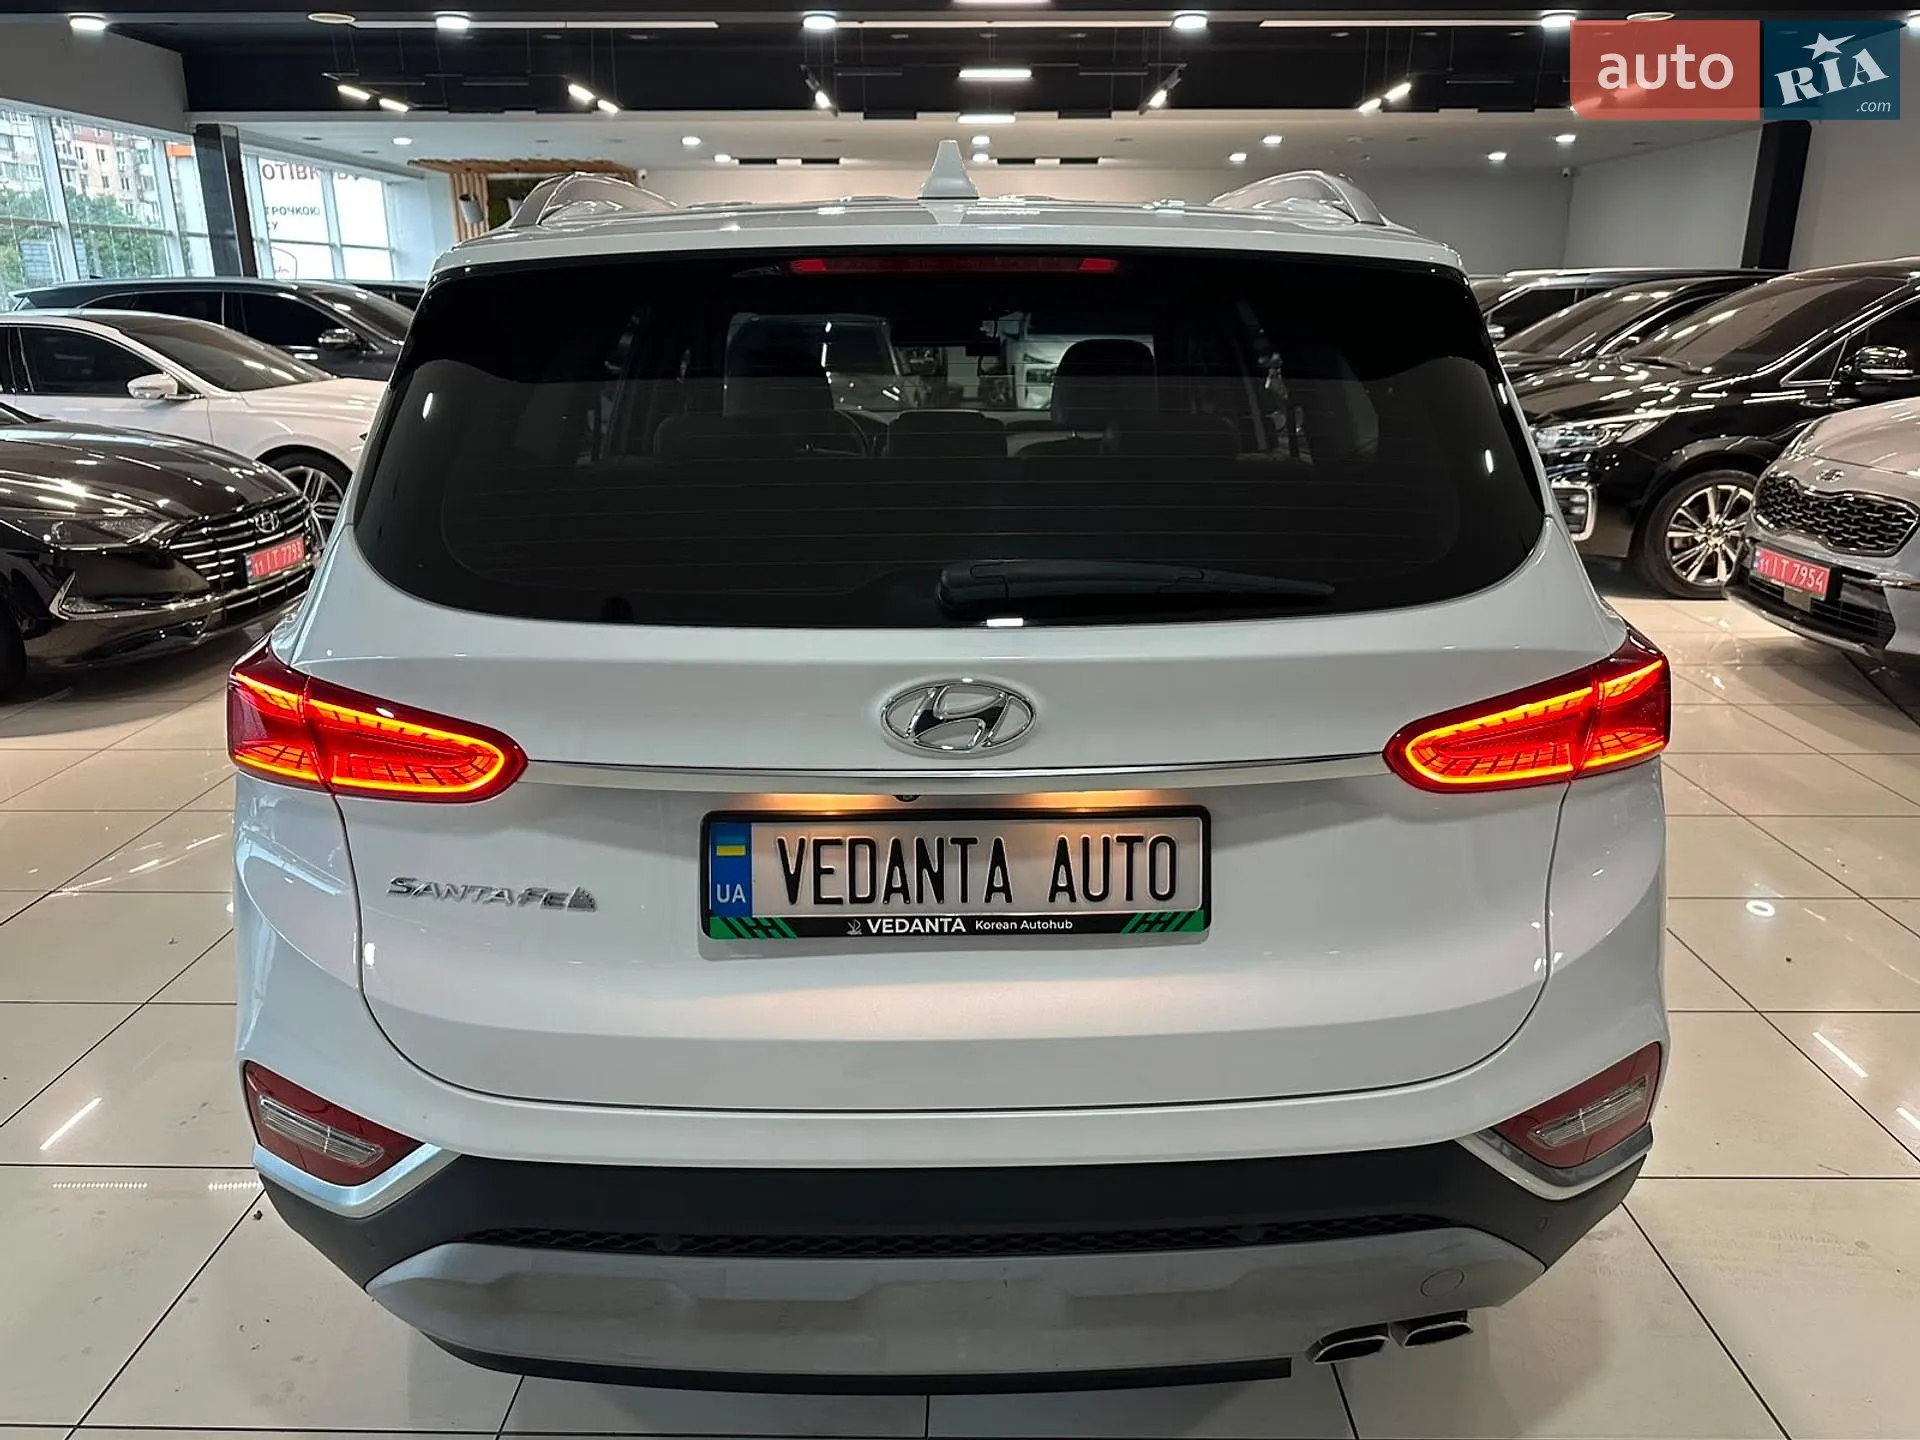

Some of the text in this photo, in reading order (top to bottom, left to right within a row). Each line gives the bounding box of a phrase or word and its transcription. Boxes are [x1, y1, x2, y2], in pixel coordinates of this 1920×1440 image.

[1791, 562, 1825, 593] 7954
[776, 832, 1178, 906] VEDANTA AUTO
[716, 883, 747, 905] UA
[866, 917, 1073, 934] VEDANTA Korean Autohub
